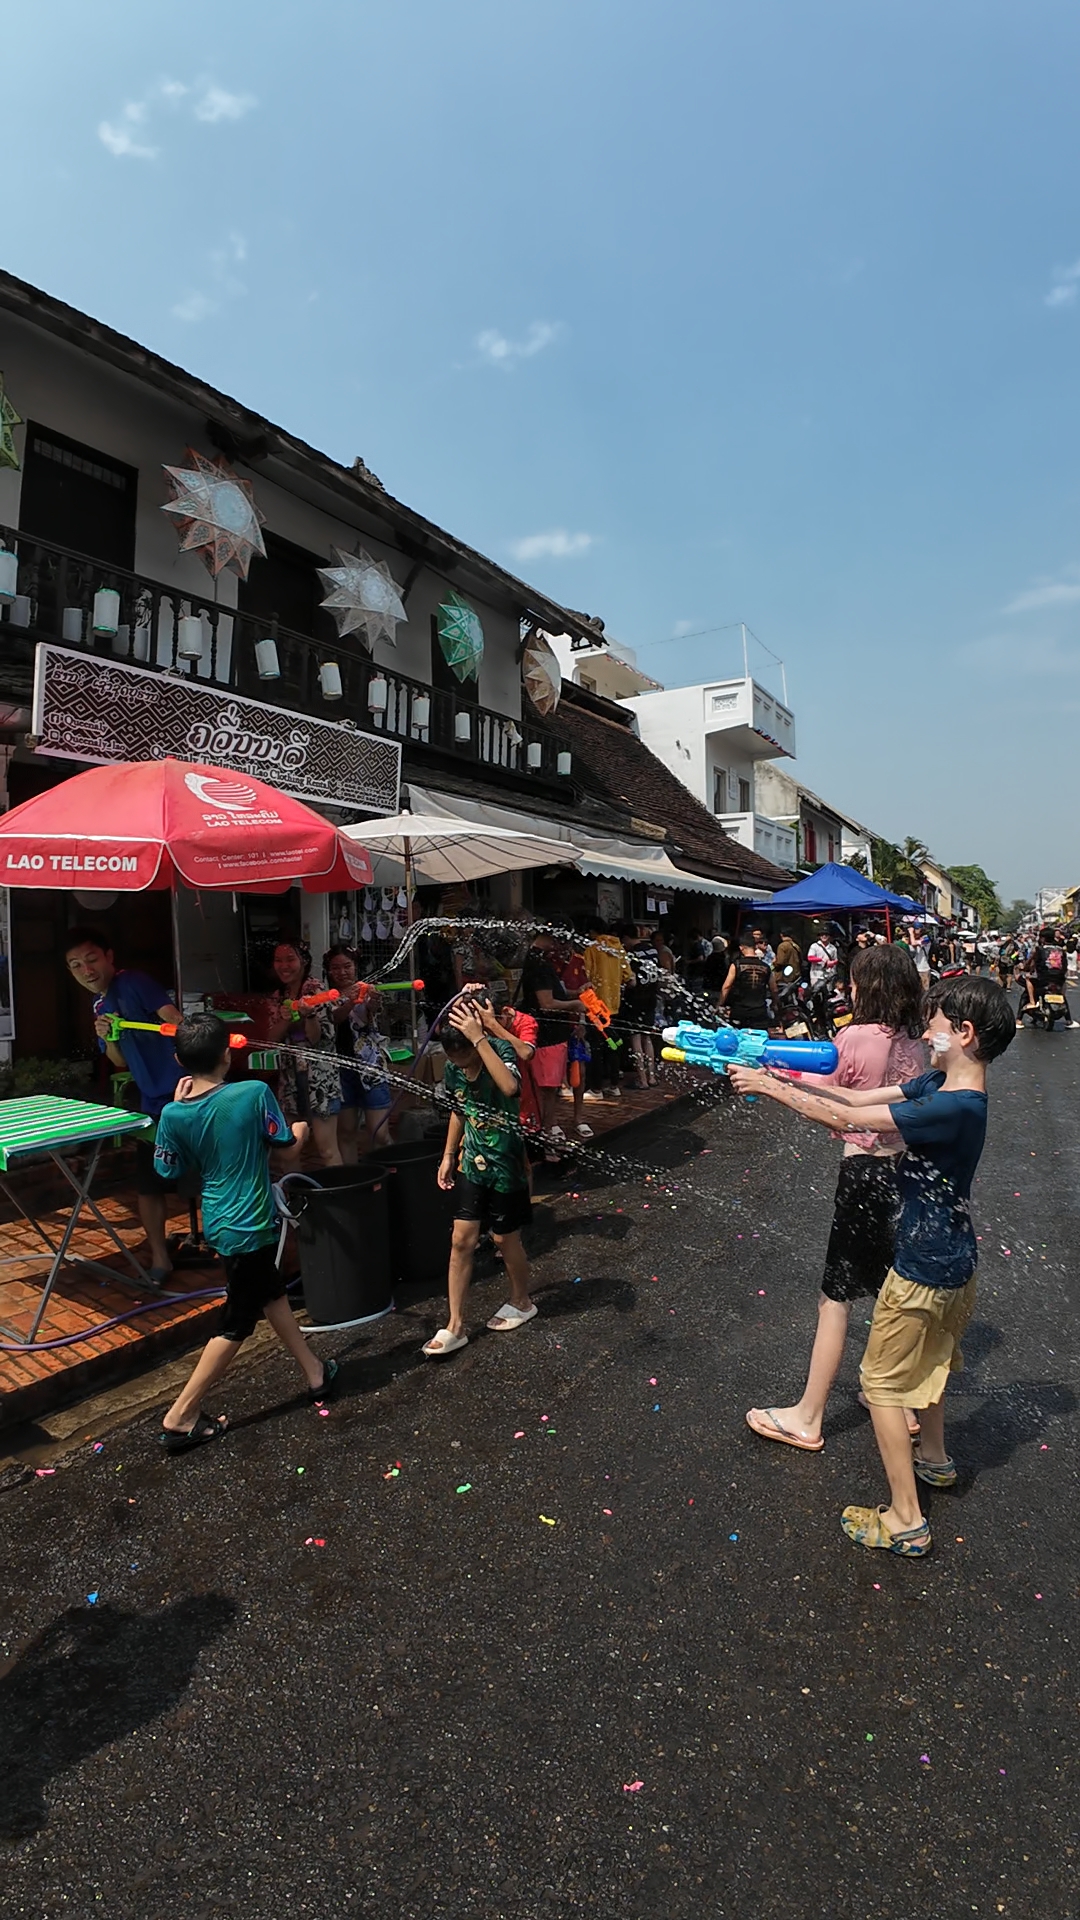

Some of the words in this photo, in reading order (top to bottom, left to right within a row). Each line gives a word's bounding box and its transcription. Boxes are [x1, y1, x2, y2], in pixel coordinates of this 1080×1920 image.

[252, 765, 269, 778] Lao
[269, 769, 304, 788] Clothing
[206, 820, 231, 828] LAO
[231, 818, 283, 826] TELECOM
[6, 854, 44, 869] LAO
[49, 855, 138, 871] TELECOM
